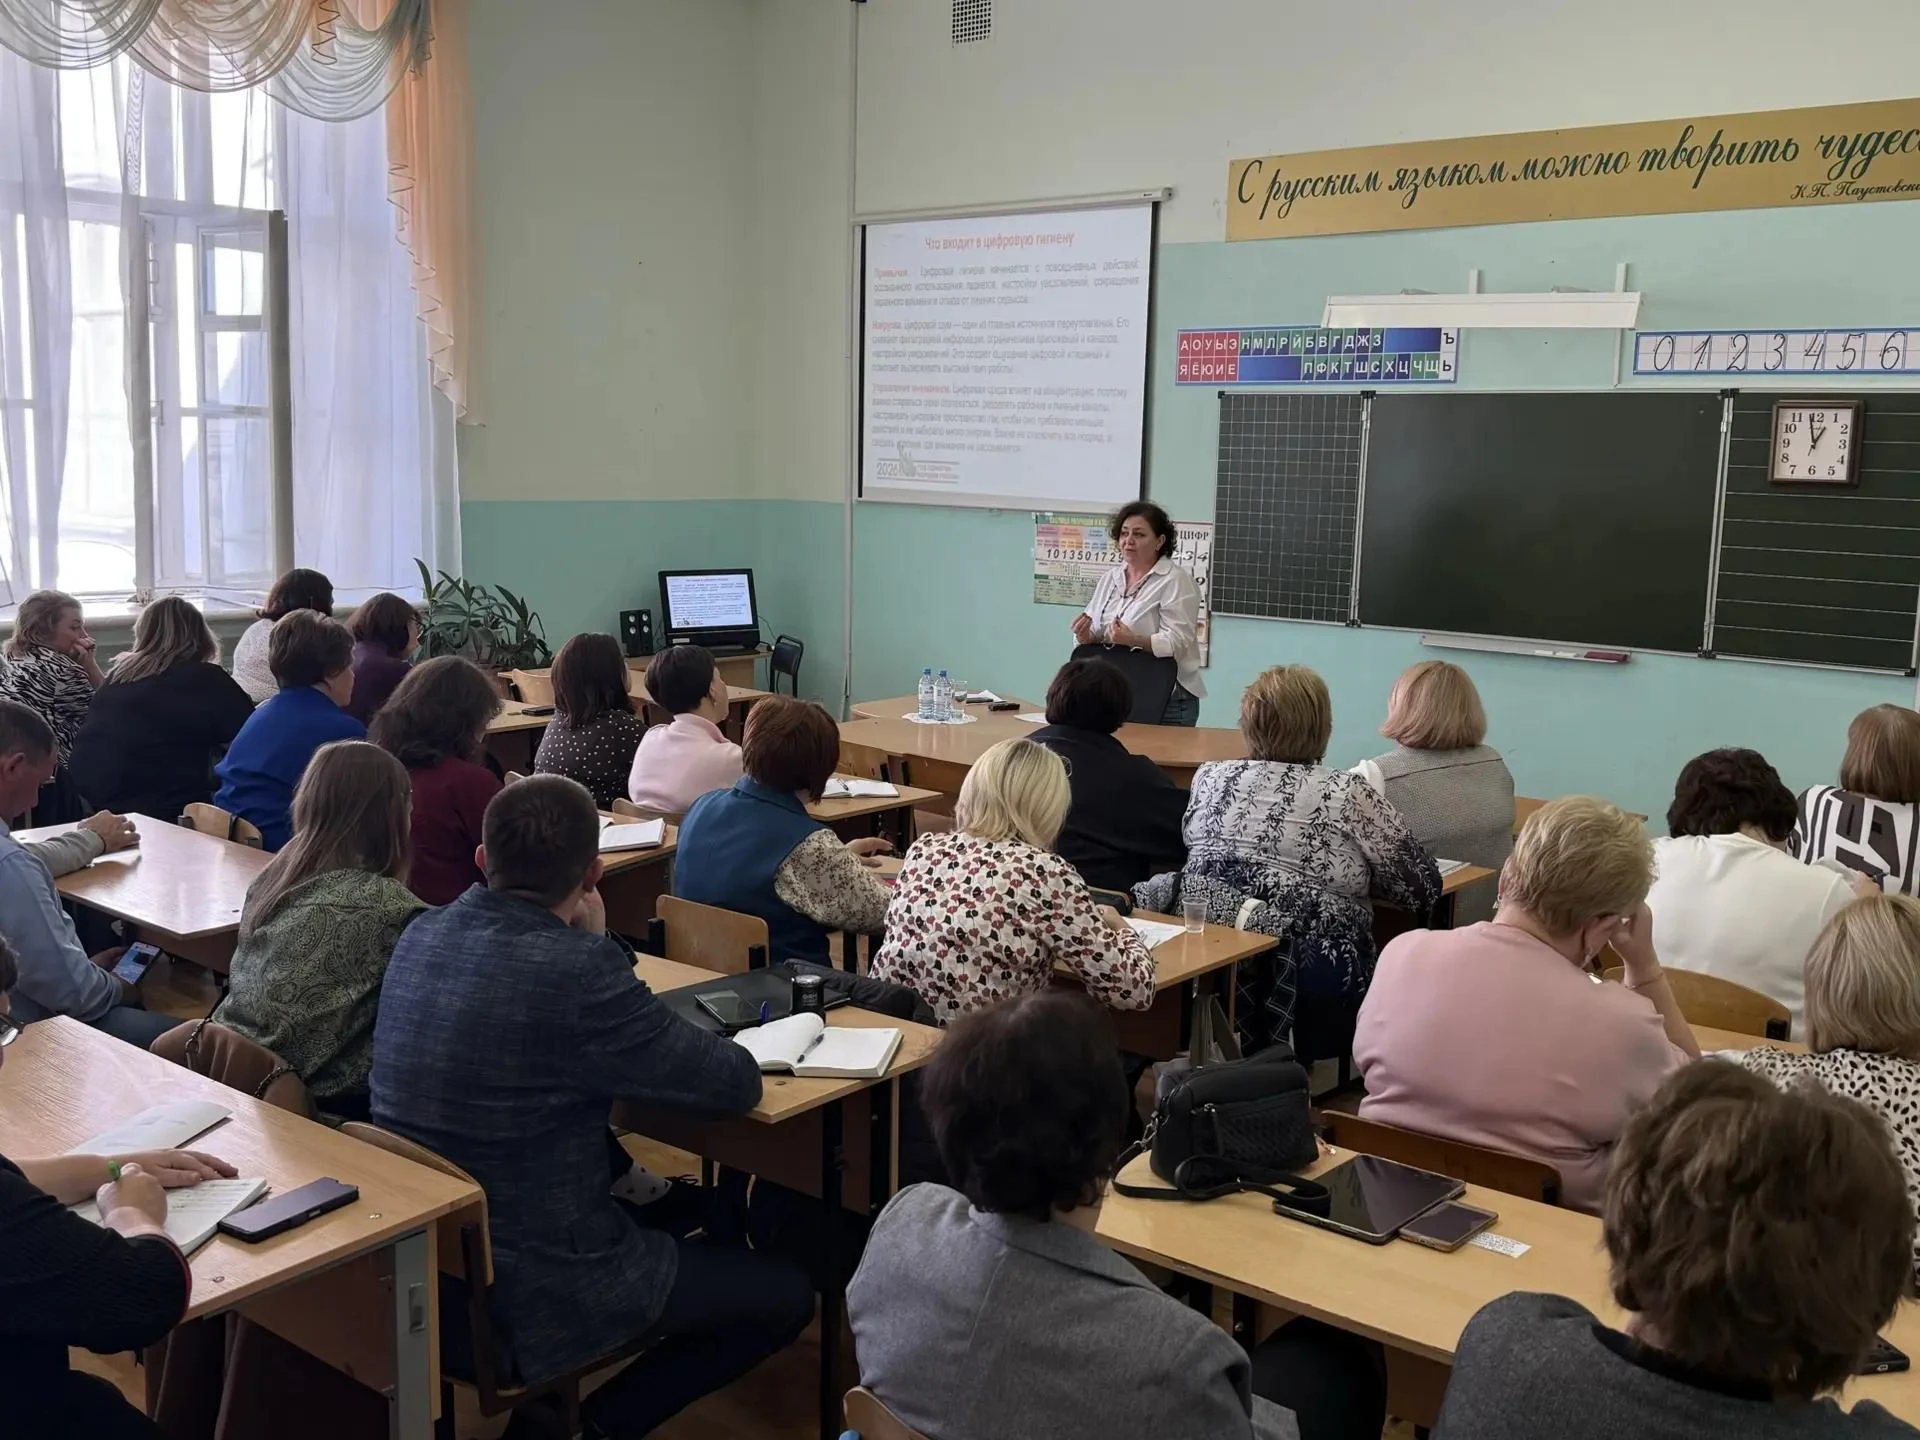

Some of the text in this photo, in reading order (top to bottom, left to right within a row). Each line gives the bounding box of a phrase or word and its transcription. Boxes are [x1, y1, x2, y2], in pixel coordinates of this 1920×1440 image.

[1237, 124, 1920, 220] С русским языком можно творить чудес
[925, 232, 1075, 250] Что входит в цифровую гигиену
[1180, 333, 1455, 350] А О У Ы Э Н М Л Р Й Б В Г Д Ж З Ъ
[1653, 331, 1906, 371] 0 1 2 3 4 5 6
[1180, 364, 1188, 375] Я
[1202, 364, 1213, 375] Ю
[1216, 364, 1224, 374] И
[1228, 364, 1236, 374] Е
[1304, 362, 1312, 374] П
[1316, 362, 1327, 373] Ф
[1331, 362, 1339, 373] К
[1344, 362, 1352, 373] Т
[1355, 362, 1368, 373] Ш
[1371, 361, 1380, 373] С
[1385, 361, 1394, 373] Х
[1398, 360, 1408, 375] Ц
[1413, 360, 1422, 372] Ч
[1425, 359, 1439, 374] Щ
[1442, 360, 1452, 372] Ь
[1791, 412, 1802, 422] 11
[1808, 412, 1825, 423] 12
[1833, 413, 1839, 423] 1
[1784, 423, 1797, 433] 10
[1840, 424, 1848, 434] 2
[1782, 438, 1790, 448] 9
[1838, 439, 1847, 449] 3
[1781, 453, 1789, 463] 8
[1836, 455, 1844, 465] 4
[1789, 465, 1797, 475] 7
[1808, 465, 1816, 475] 6
[1827, 465, 1836, 476] 5
[1180, 530, 1209, 541] ЦИФР
[1182, 550, 1194, 561] 3
[1197, 551, 1209, 562] 4
